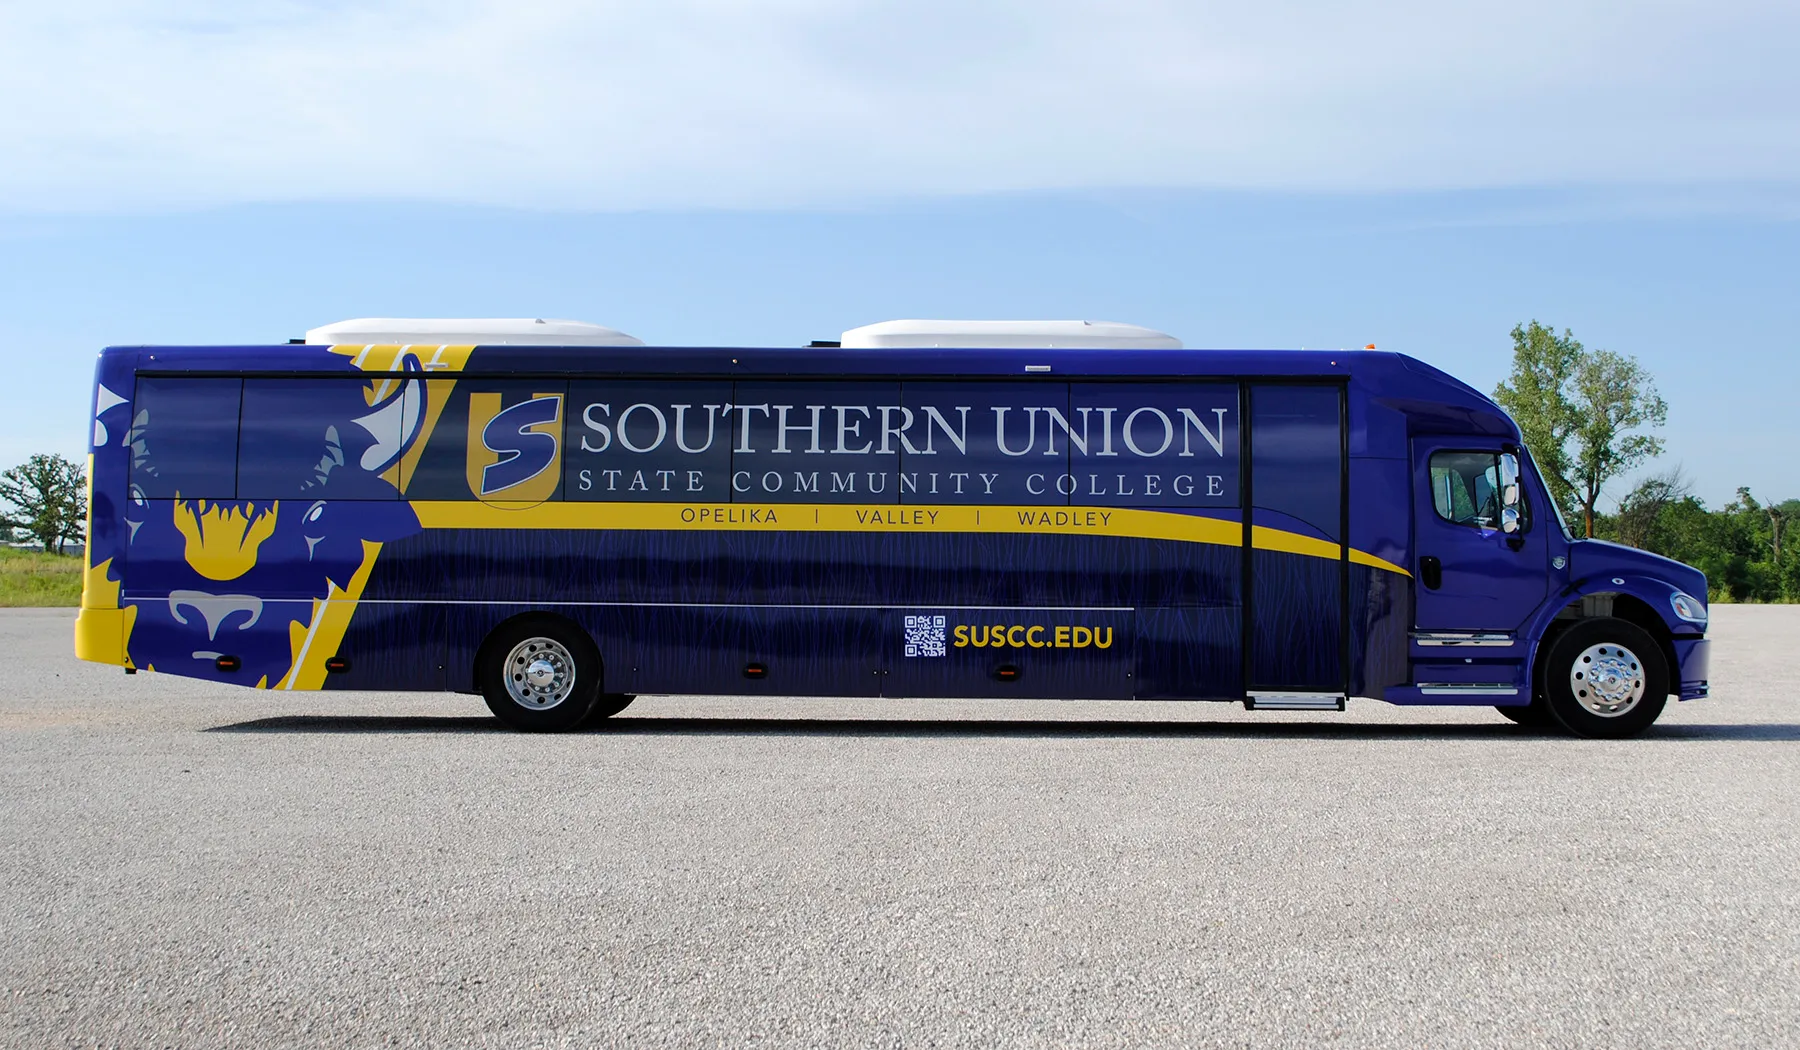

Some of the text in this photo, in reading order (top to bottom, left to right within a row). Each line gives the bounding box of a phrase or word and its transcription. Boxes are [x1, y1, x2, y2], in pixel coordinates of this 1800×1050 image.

[580, 402, 1228, 457] SOUTHERN UNION
[578, 469, 1224, 496] STATE COMMUNITY COLLEGE
[680, 508, 1113, 526] OPELIKA VALLEY WADLEY
[953, 625, 1113, 649] SUSCC.EDU
